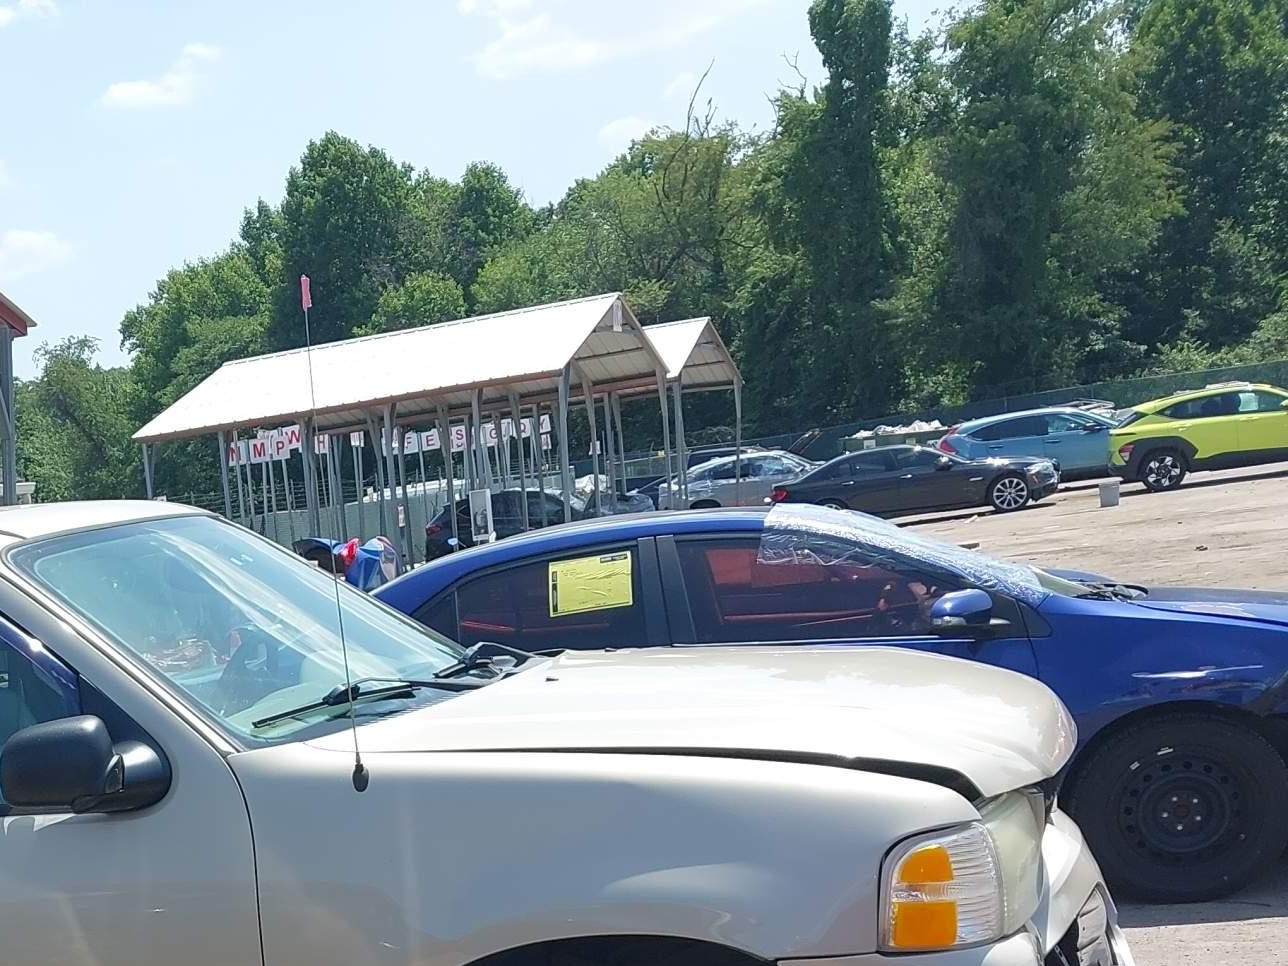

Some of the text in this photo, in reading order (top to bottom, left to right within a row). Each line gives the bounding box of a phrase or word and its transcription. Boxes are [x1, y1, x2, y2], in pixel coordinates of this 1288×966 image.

[426, 434, 436, 447] E
[455, 428, 464, 440] S
[253, 442, 266, 458] M
[275, 441, 285, 455] P
